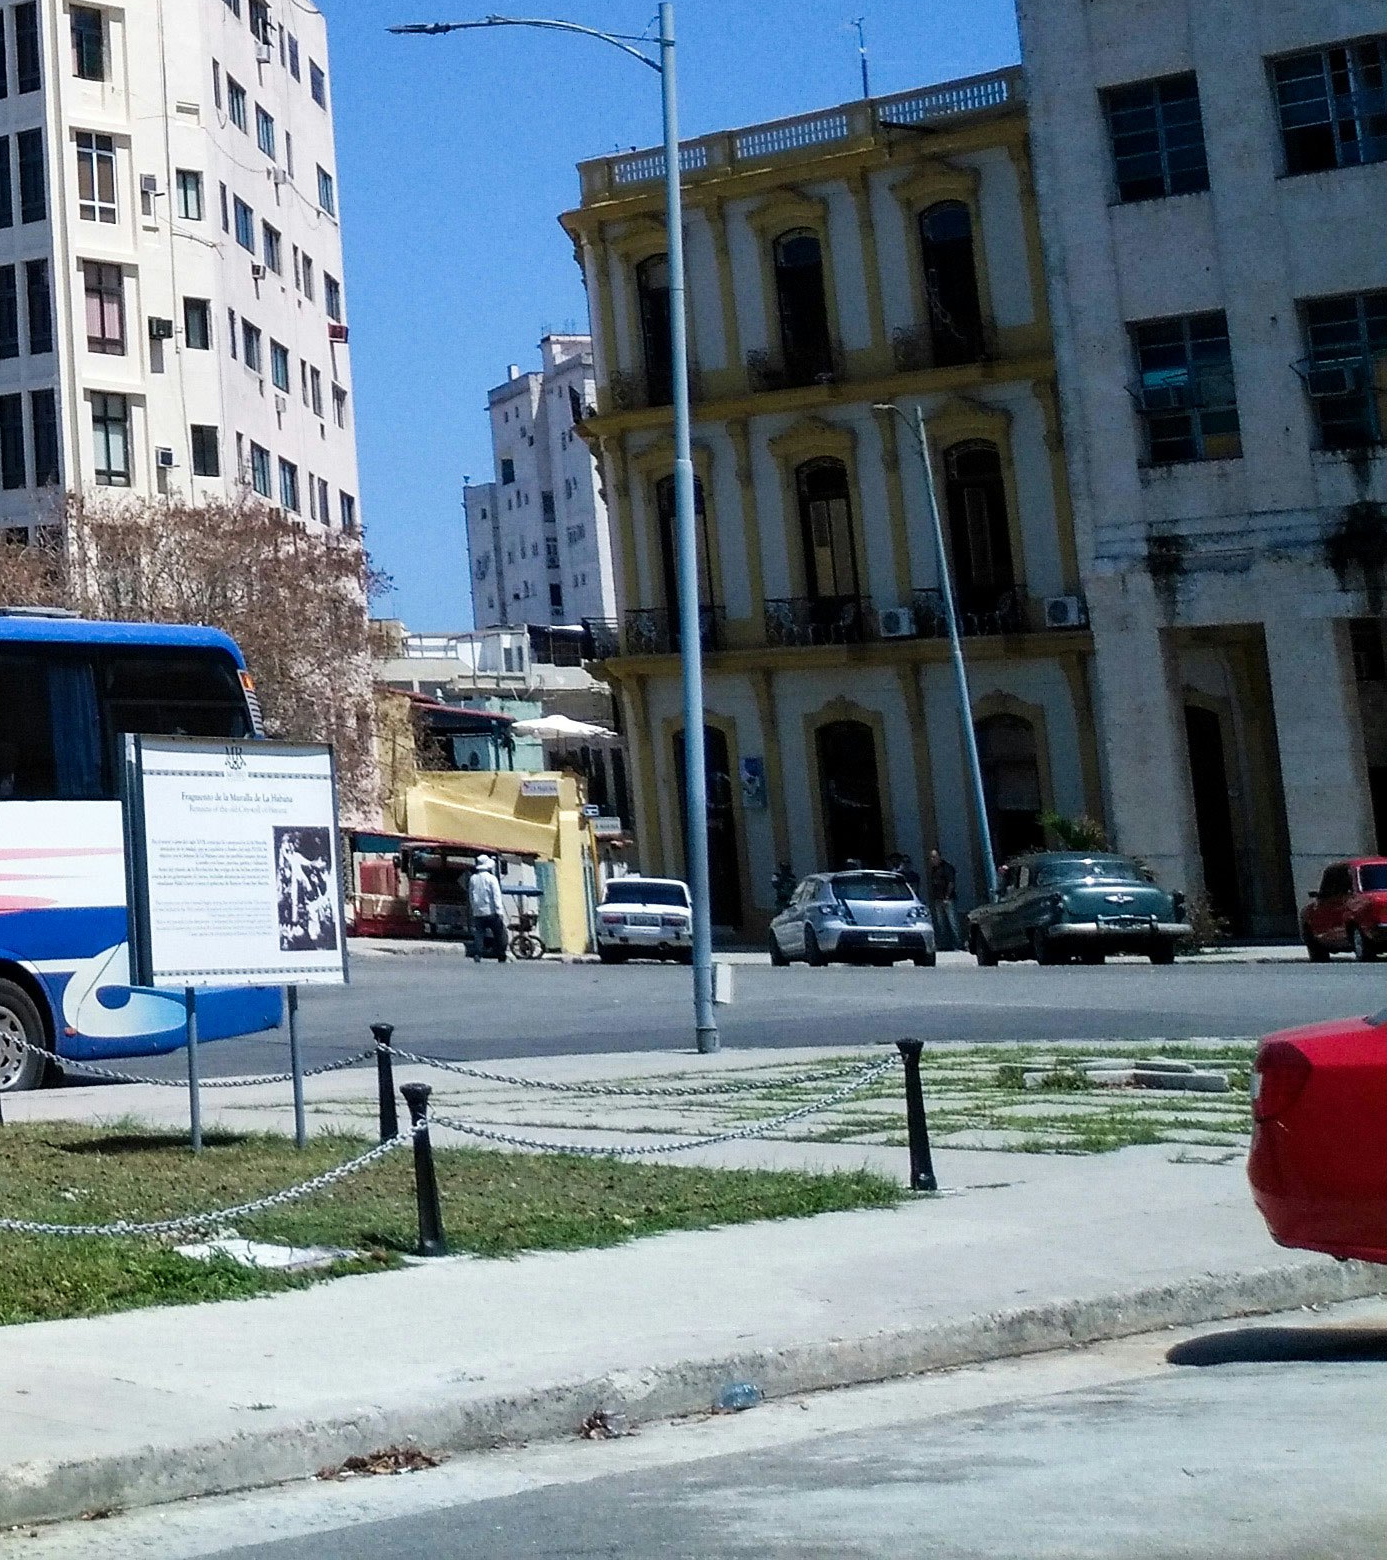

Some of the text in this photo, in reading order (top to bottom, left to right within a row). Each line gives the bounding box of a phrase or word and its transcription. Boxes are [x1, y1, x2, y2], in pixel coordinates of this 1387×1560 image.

[181, 791, 213, 802] Fragmento
[214, 792, 222, 801] de
[254, 793, 261, 802] de
[271, 793, 293, 803] Habana
